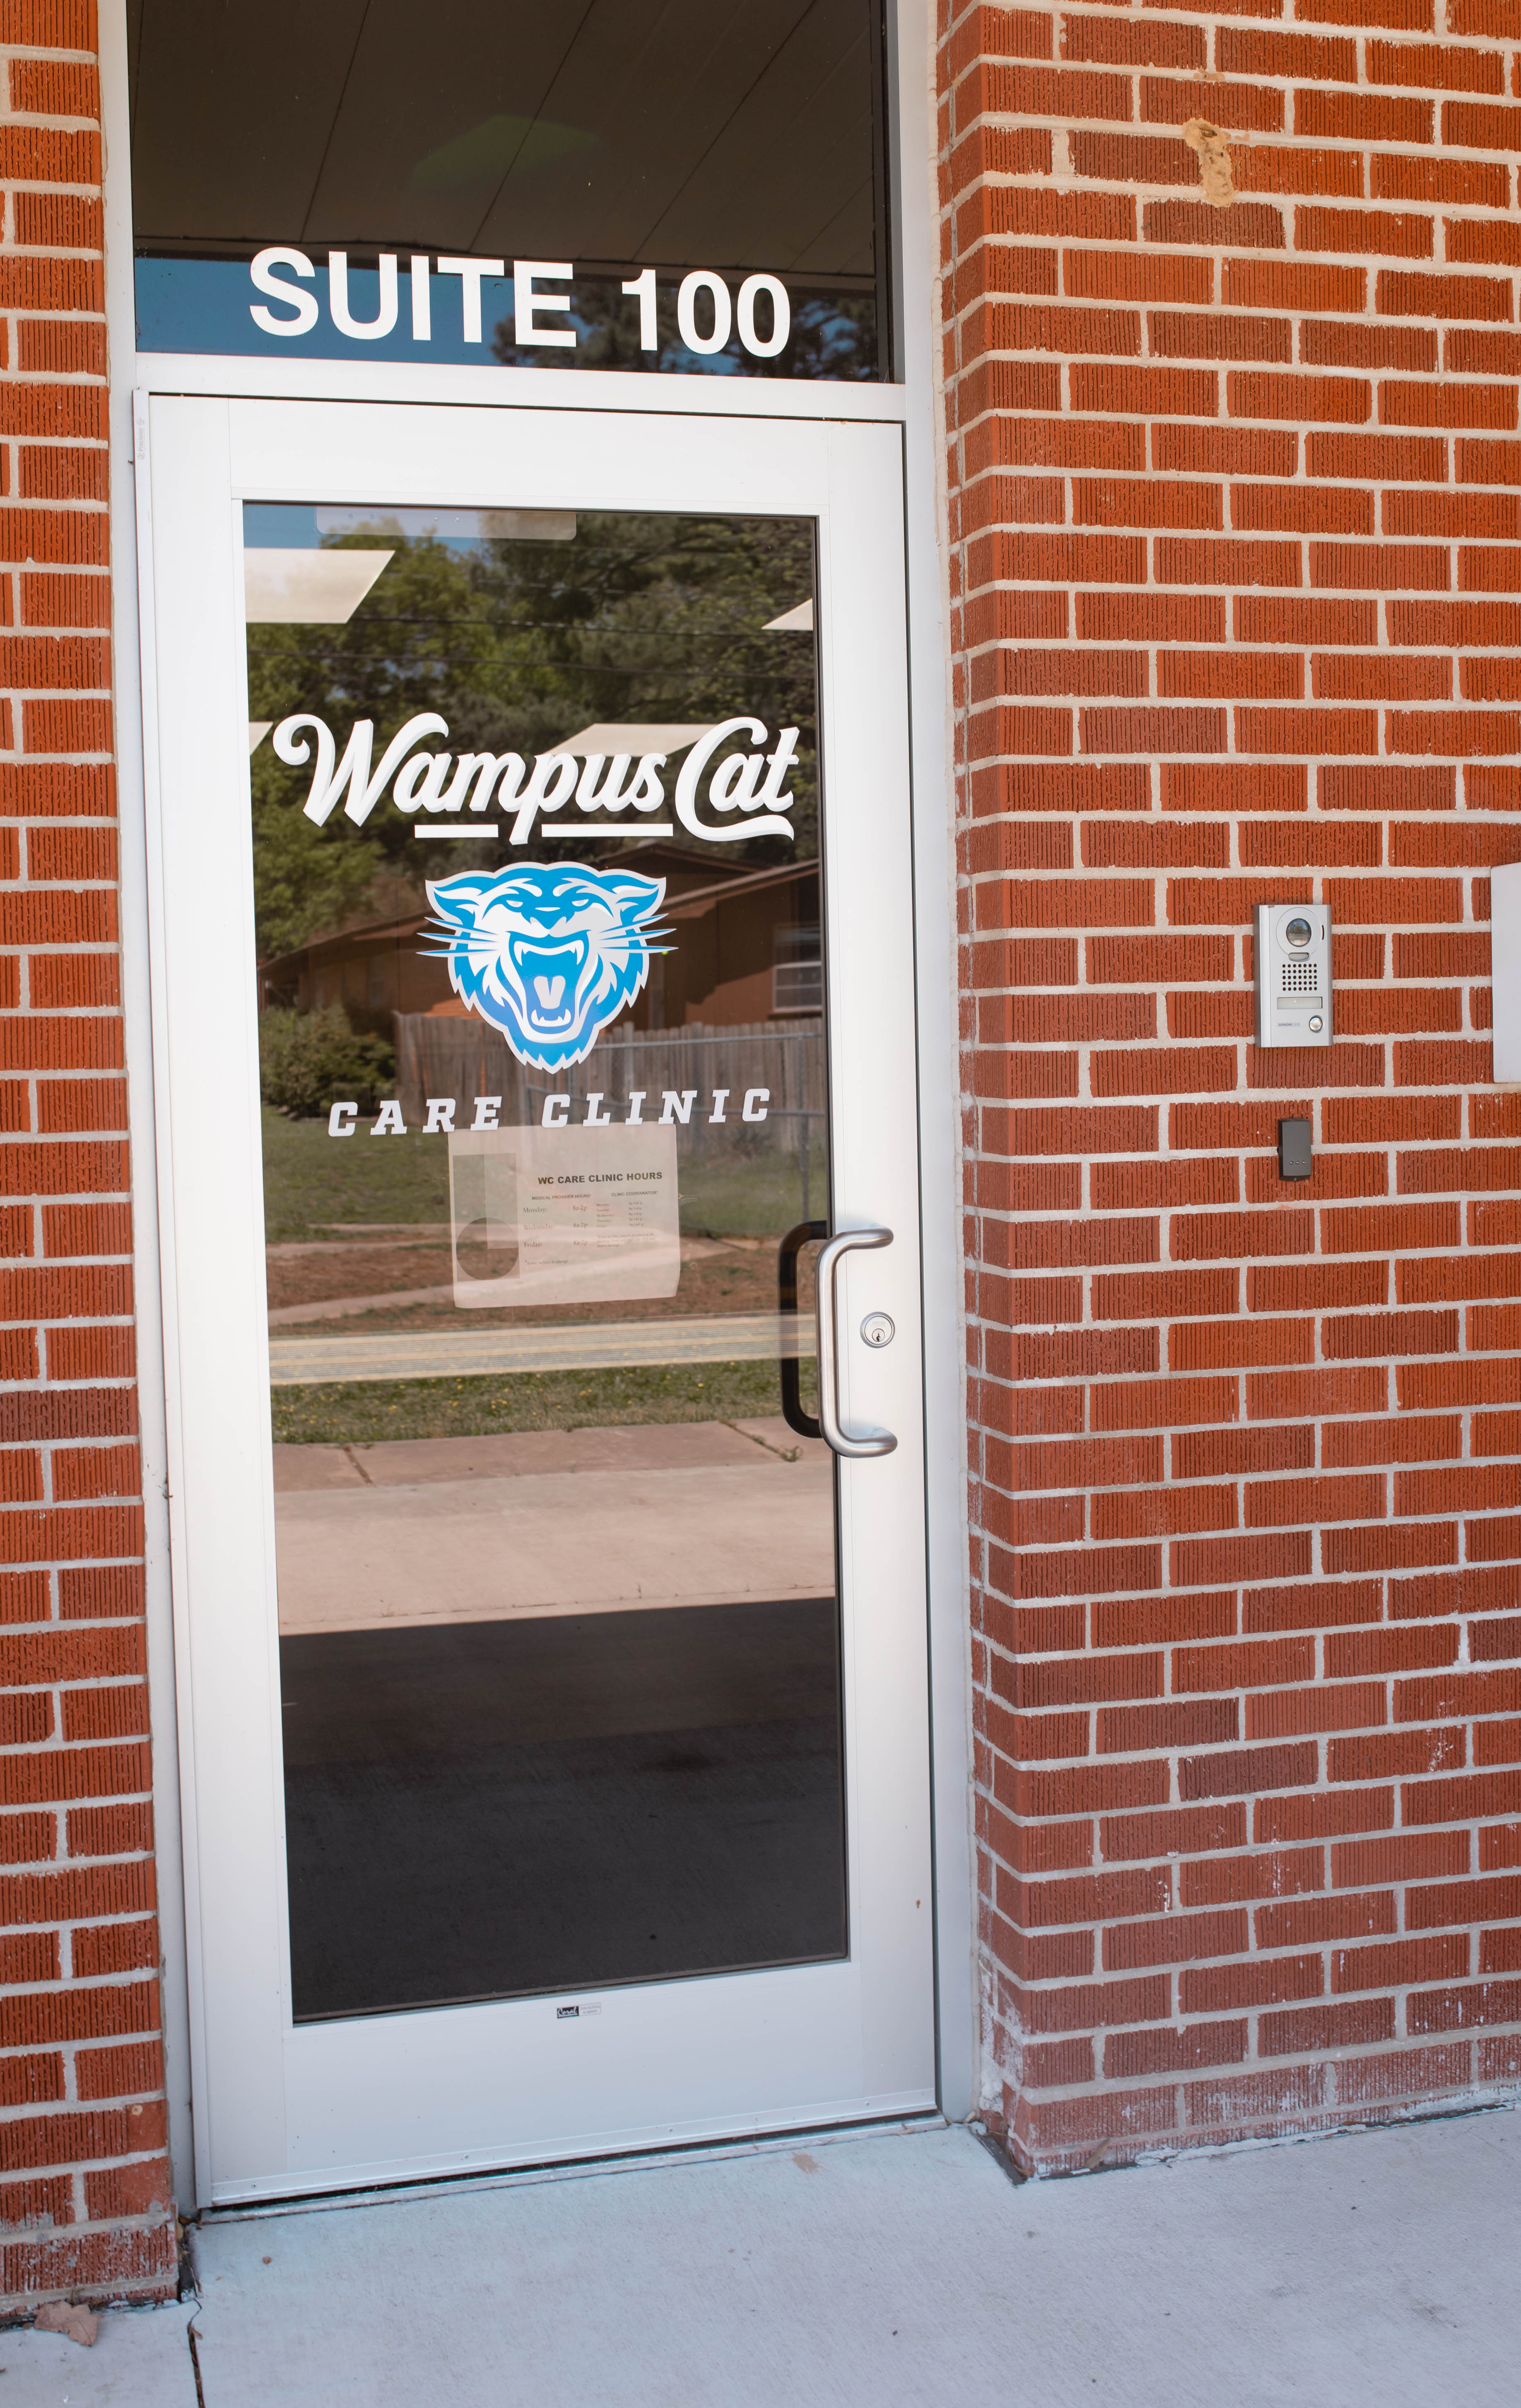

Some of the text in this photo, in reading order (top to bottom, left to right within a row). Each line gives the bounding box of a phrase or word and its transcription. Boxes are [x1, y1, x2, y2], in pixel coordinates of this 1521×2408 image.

[250, 247, 790, 357] SUITE 100
[273, 713, 800, 845] Wampus Cat
[328, 1088, 770, 1136] CARE CLINIC
[627, 1172, 663, 1181] HOURS
